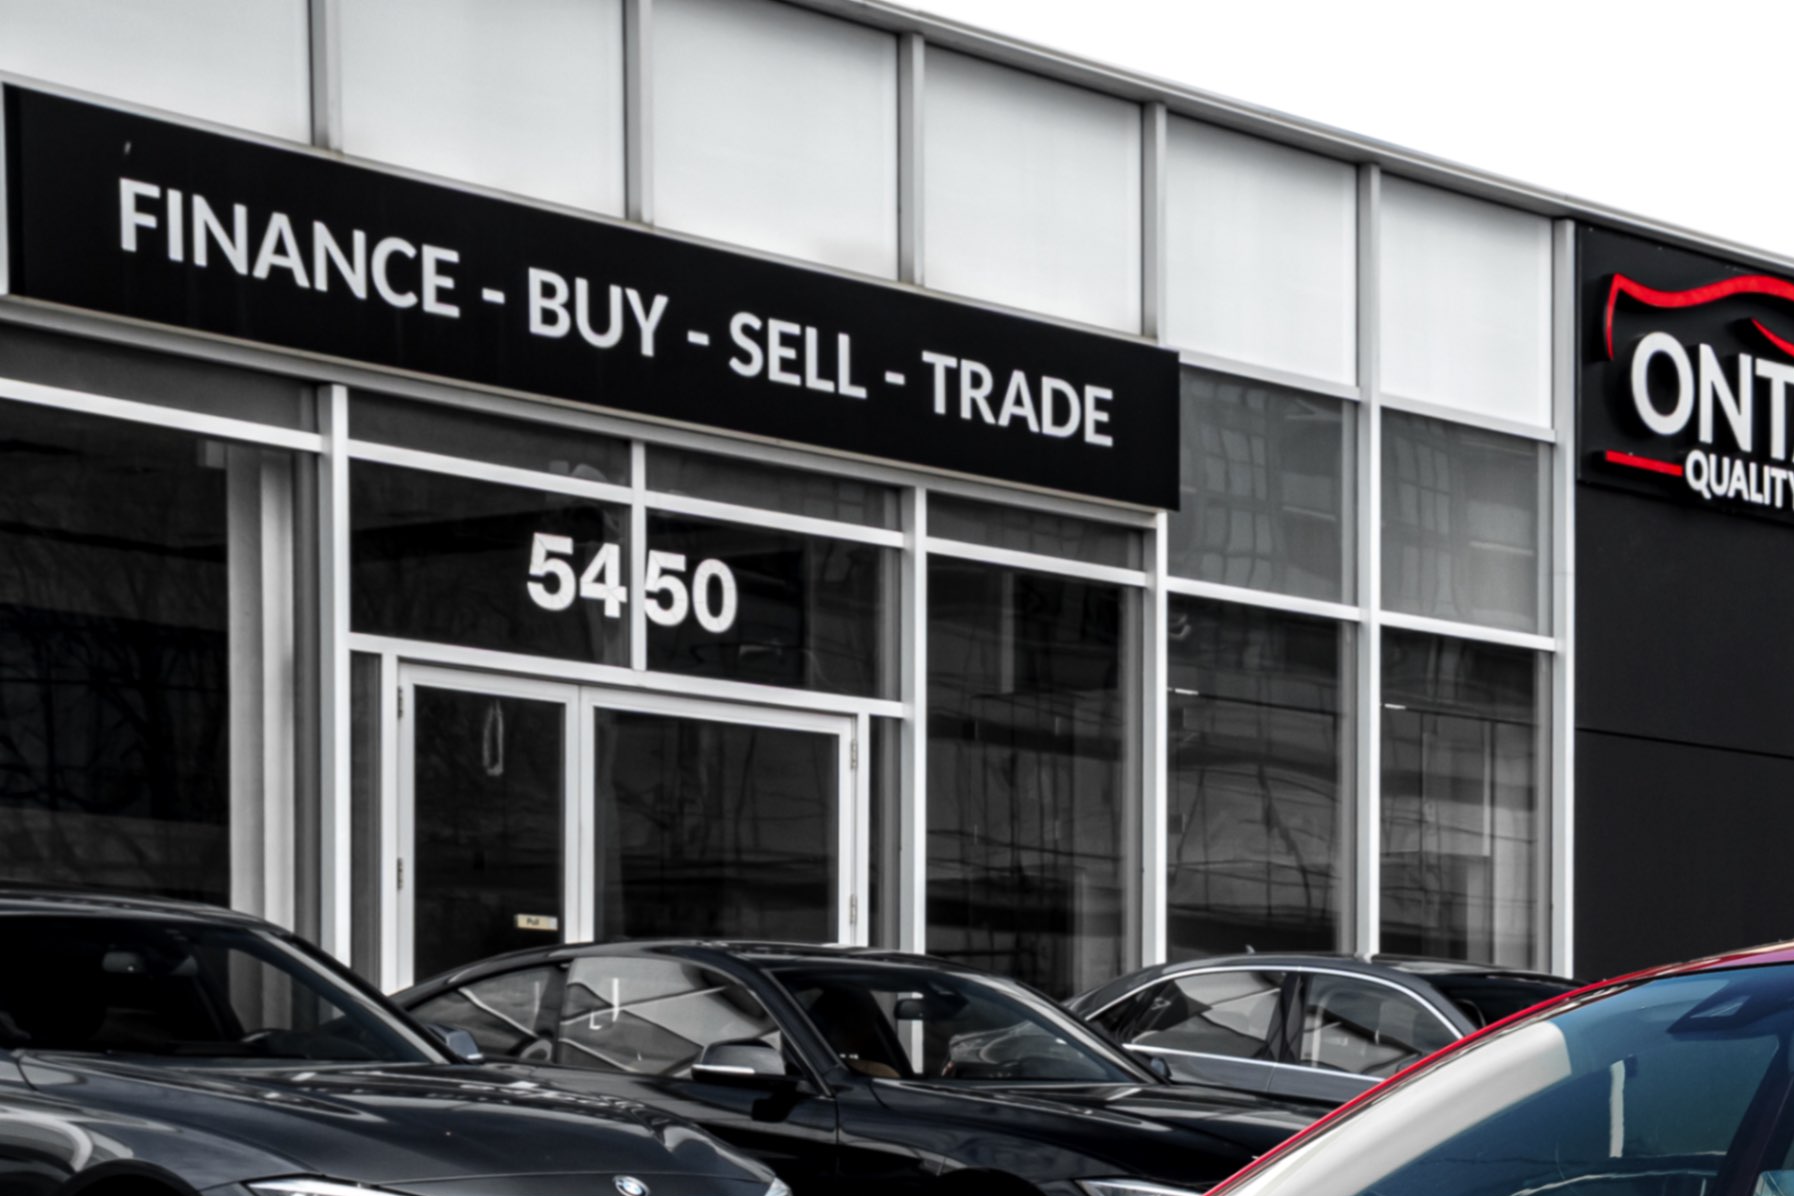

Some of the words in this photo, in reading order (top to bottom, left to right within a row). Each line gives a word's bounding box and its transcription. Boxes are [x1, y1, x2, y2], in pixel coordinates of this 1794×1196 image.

[118, 177, 461, 318] FINANCE
[527, 266, 670, 358] BUY
[728, 311, 868, 400] SELL
[921, 350, 1114, 448] TRADE
[526, 532, 739, 634] 5450
